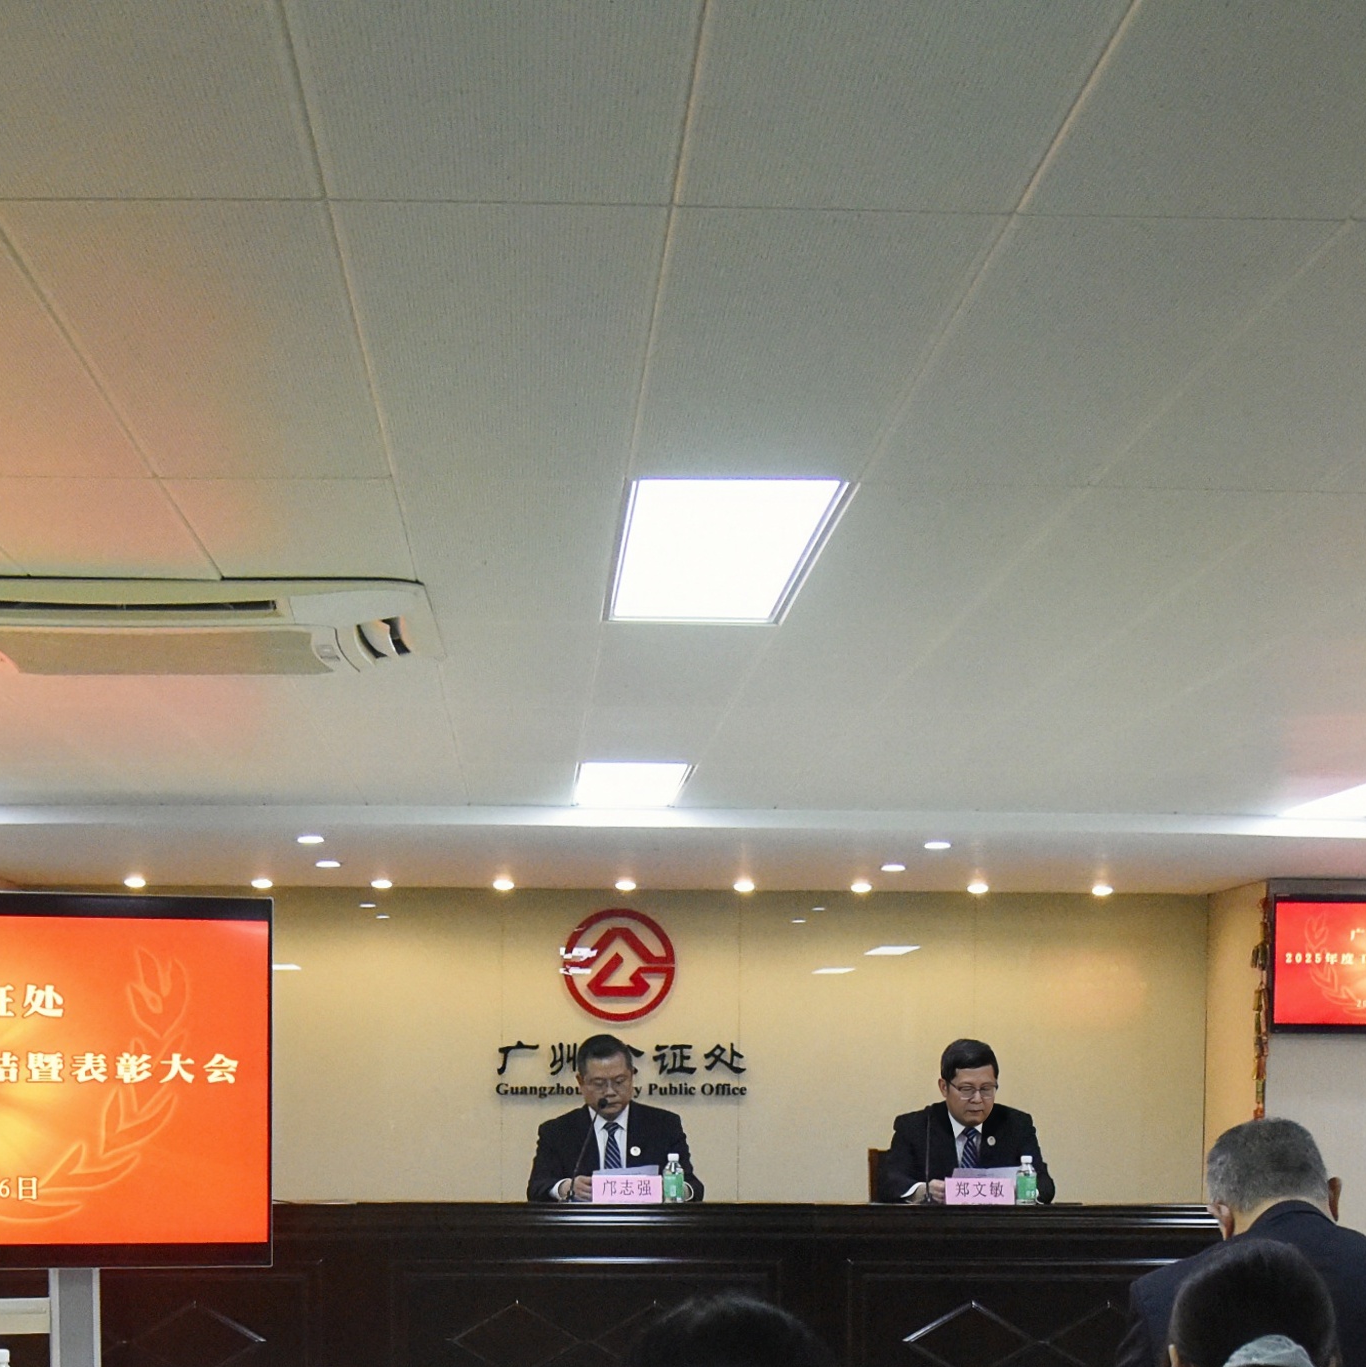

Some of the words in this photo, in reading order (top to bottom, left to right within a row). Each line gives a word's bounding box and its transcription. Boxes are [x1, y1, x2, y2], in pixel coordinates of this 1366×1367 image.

[648, 1083, 696, 1096] Public
[701, 1083, 747, 1096] Office
[955, 1181, 1005, 1198] 郑文敏
